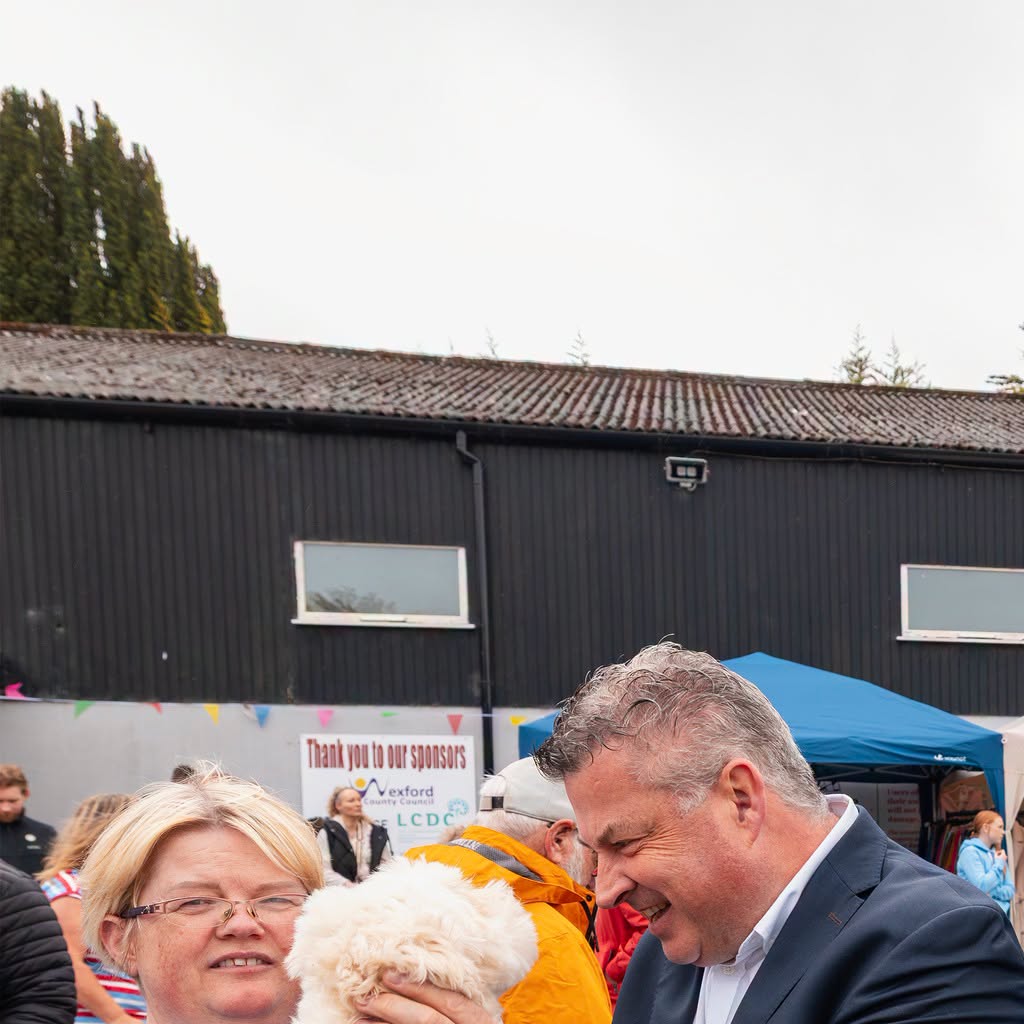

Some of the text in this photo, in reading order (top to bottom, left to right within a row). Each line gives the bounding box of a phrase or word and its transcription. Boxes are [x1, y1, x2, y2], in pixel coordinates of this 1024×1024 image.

[306, 738, 467, 772] Thank you to our sponsors
[363, 797, 435, 806] County Council
[397, 812, 455, 827] LCDC
